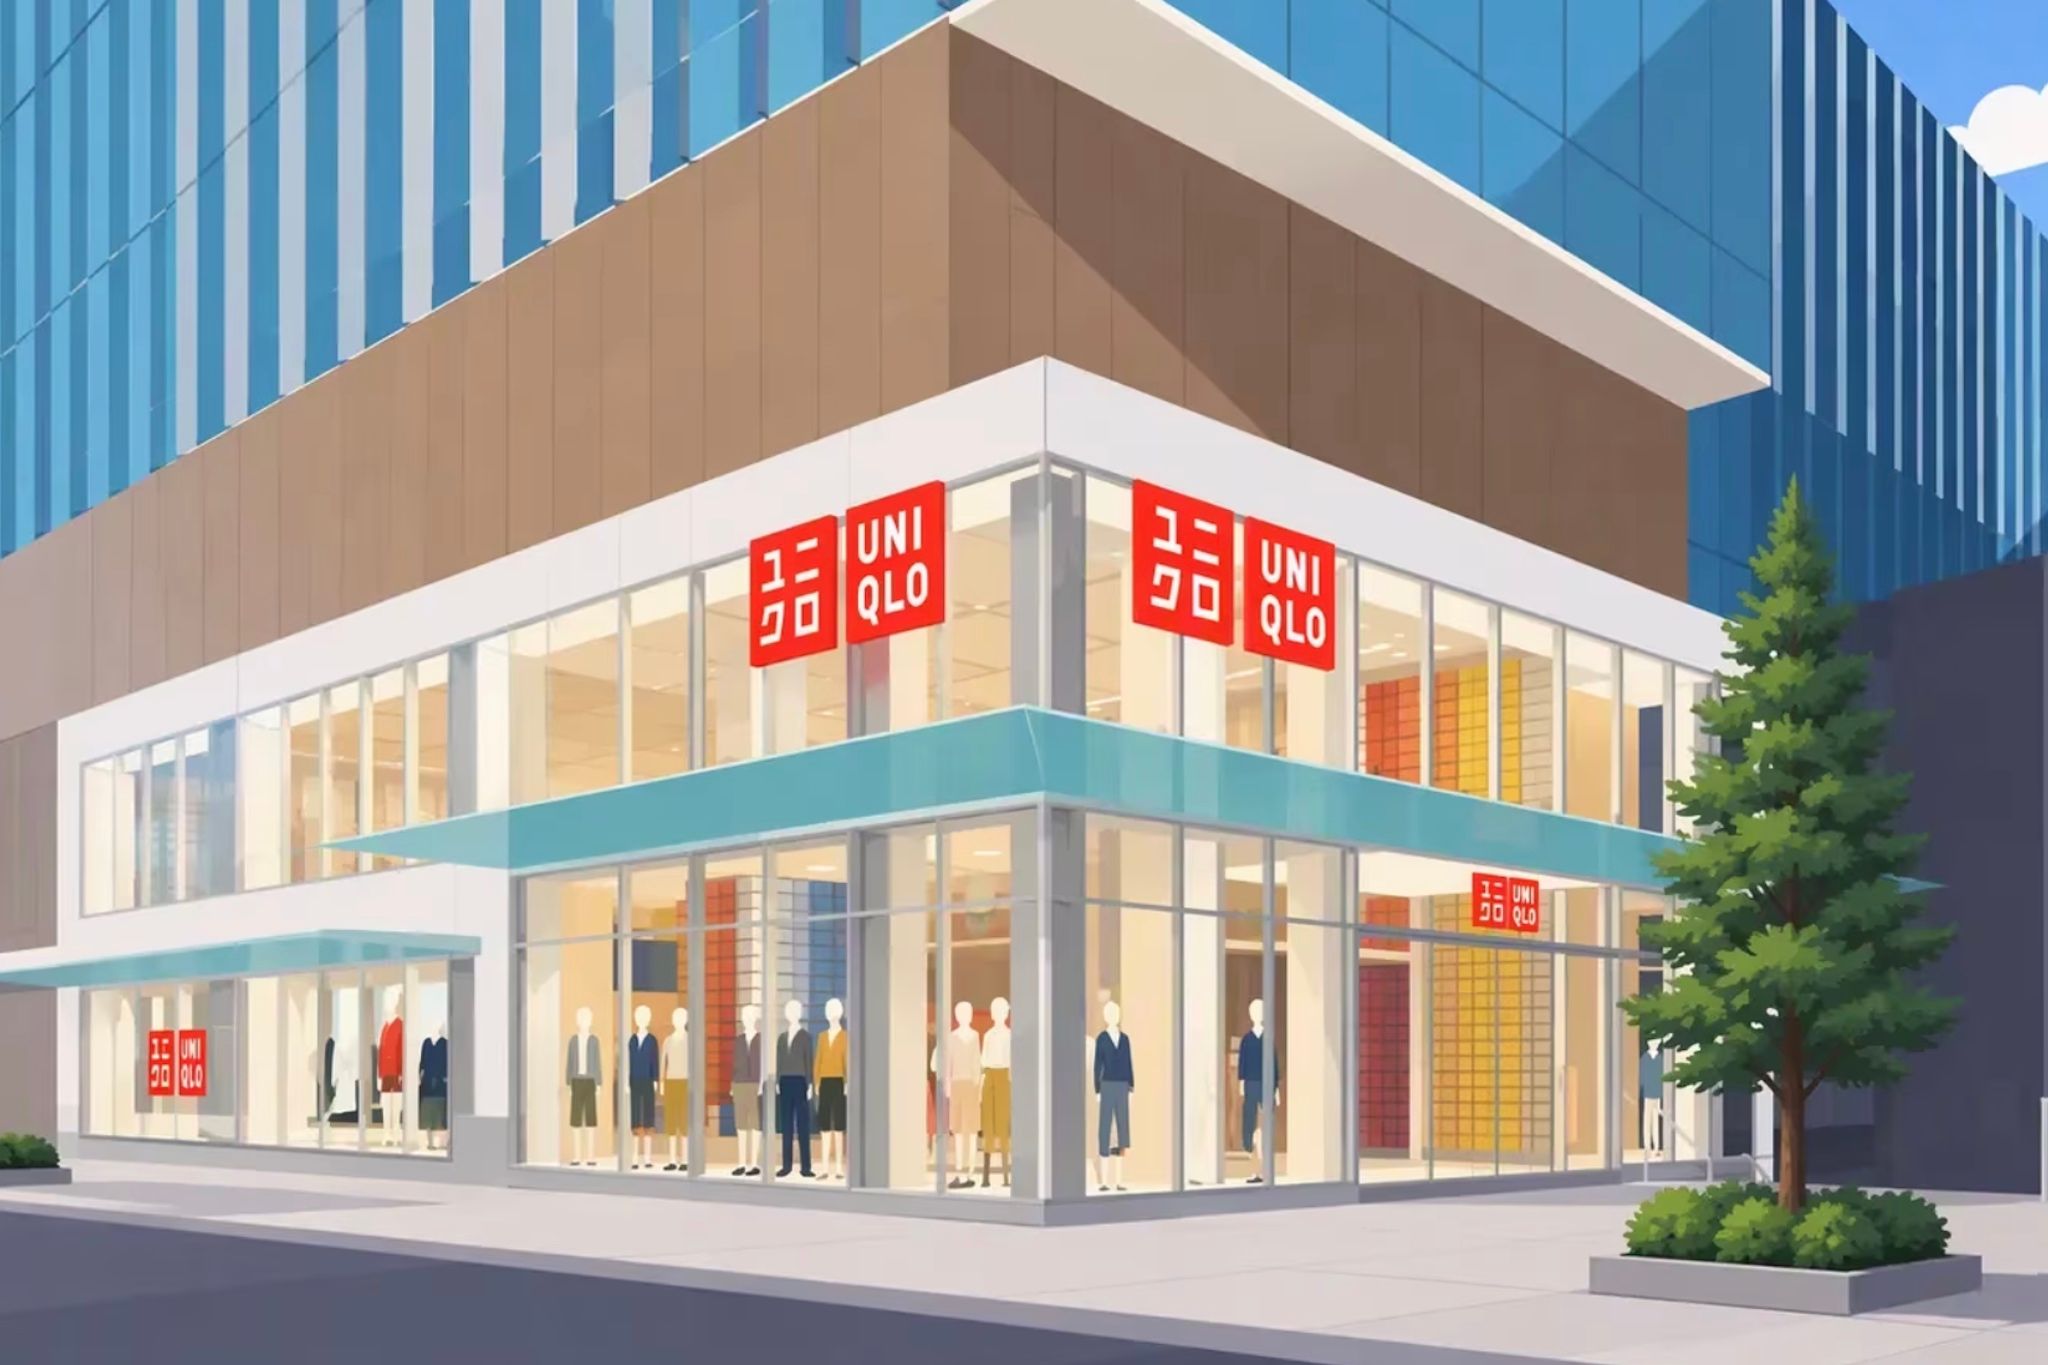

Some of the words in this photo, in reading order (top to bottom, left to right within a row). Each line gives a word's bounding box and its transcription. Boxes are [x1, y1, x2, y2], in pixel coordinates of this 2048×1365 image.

[857, 506, 922, 564] UNI
[1153, 506, 1219, 565] ユニ
[761, 538, 819, 592] ユニ
[1150, 563, 1220, 622] クロ
[1261, 539, 1320, 596] UNI
[760, 591, 819, 646] クロ
[857, 562, 929, 625] QLO
[1260, 594, 1326, 648] QLO
[1512, 905, 1536, 927] QLO
[1513, 884, 1534, 905] UNI
[180, 1064, 203, 1088] QLO
